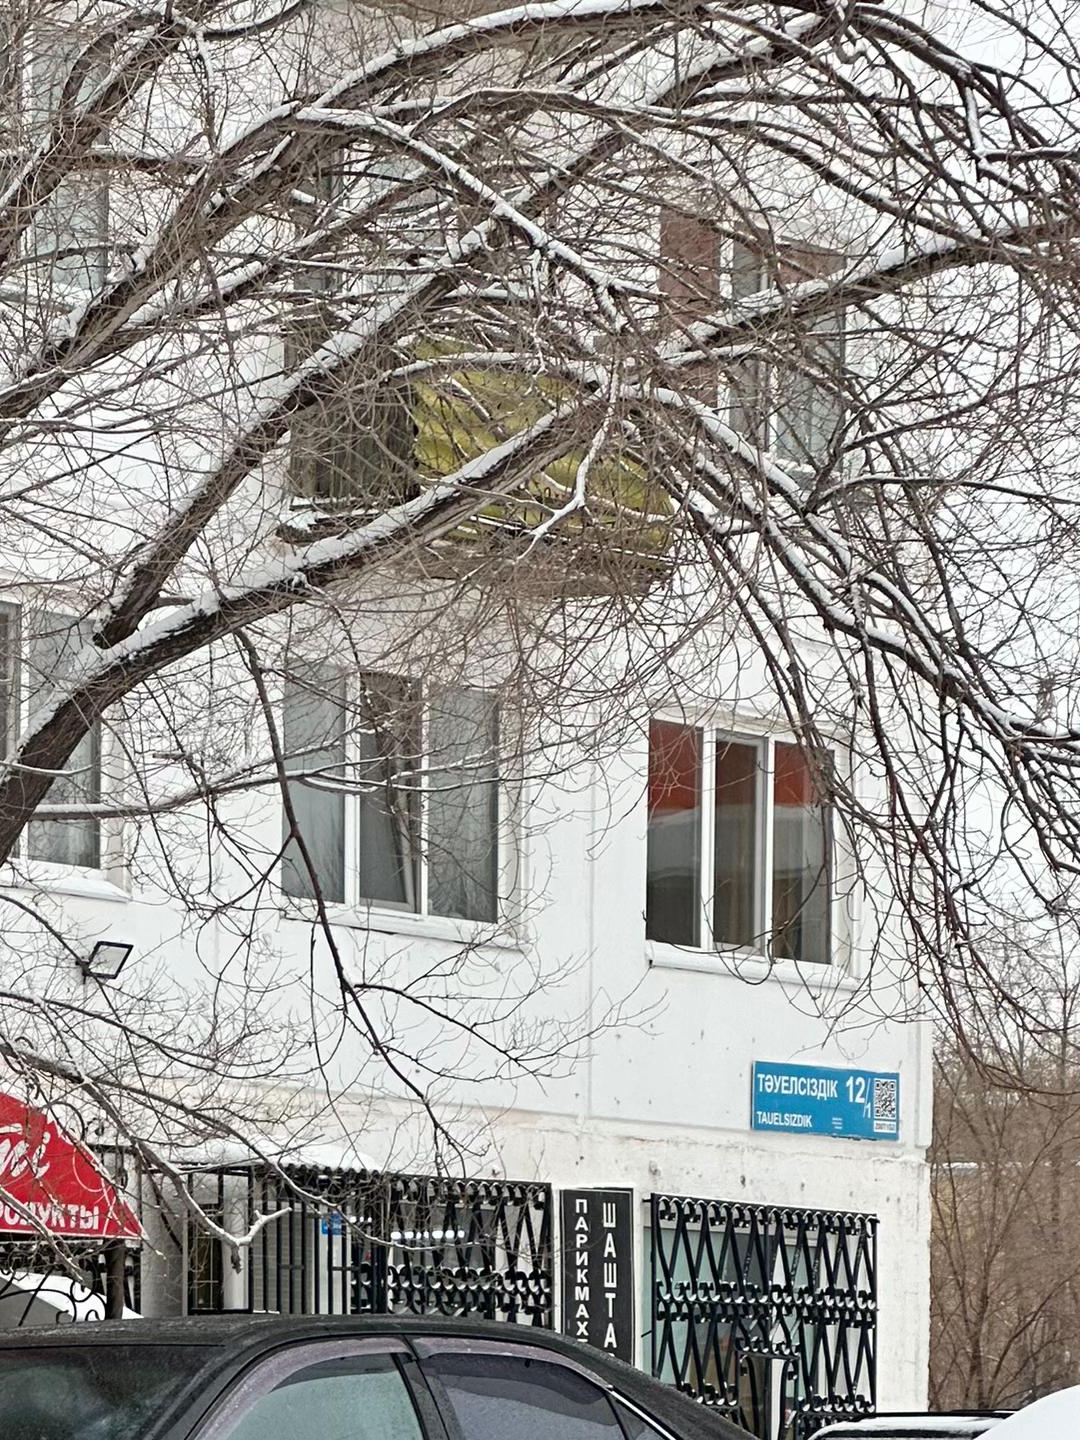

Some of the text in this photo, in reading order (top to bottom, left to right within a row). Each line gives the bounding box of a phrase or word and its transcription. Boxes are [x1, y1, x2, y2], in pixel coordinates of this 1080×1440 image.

[756, 1111, 812, 1127] TAUELSIZDIK
[757, 1073, 838, 1100] ТӘУЕЛСІЗДІК
[574, 1198, 590, 1342] ПАРИКМАХ
[602, 1202, 618, 1357] ШАШТА
